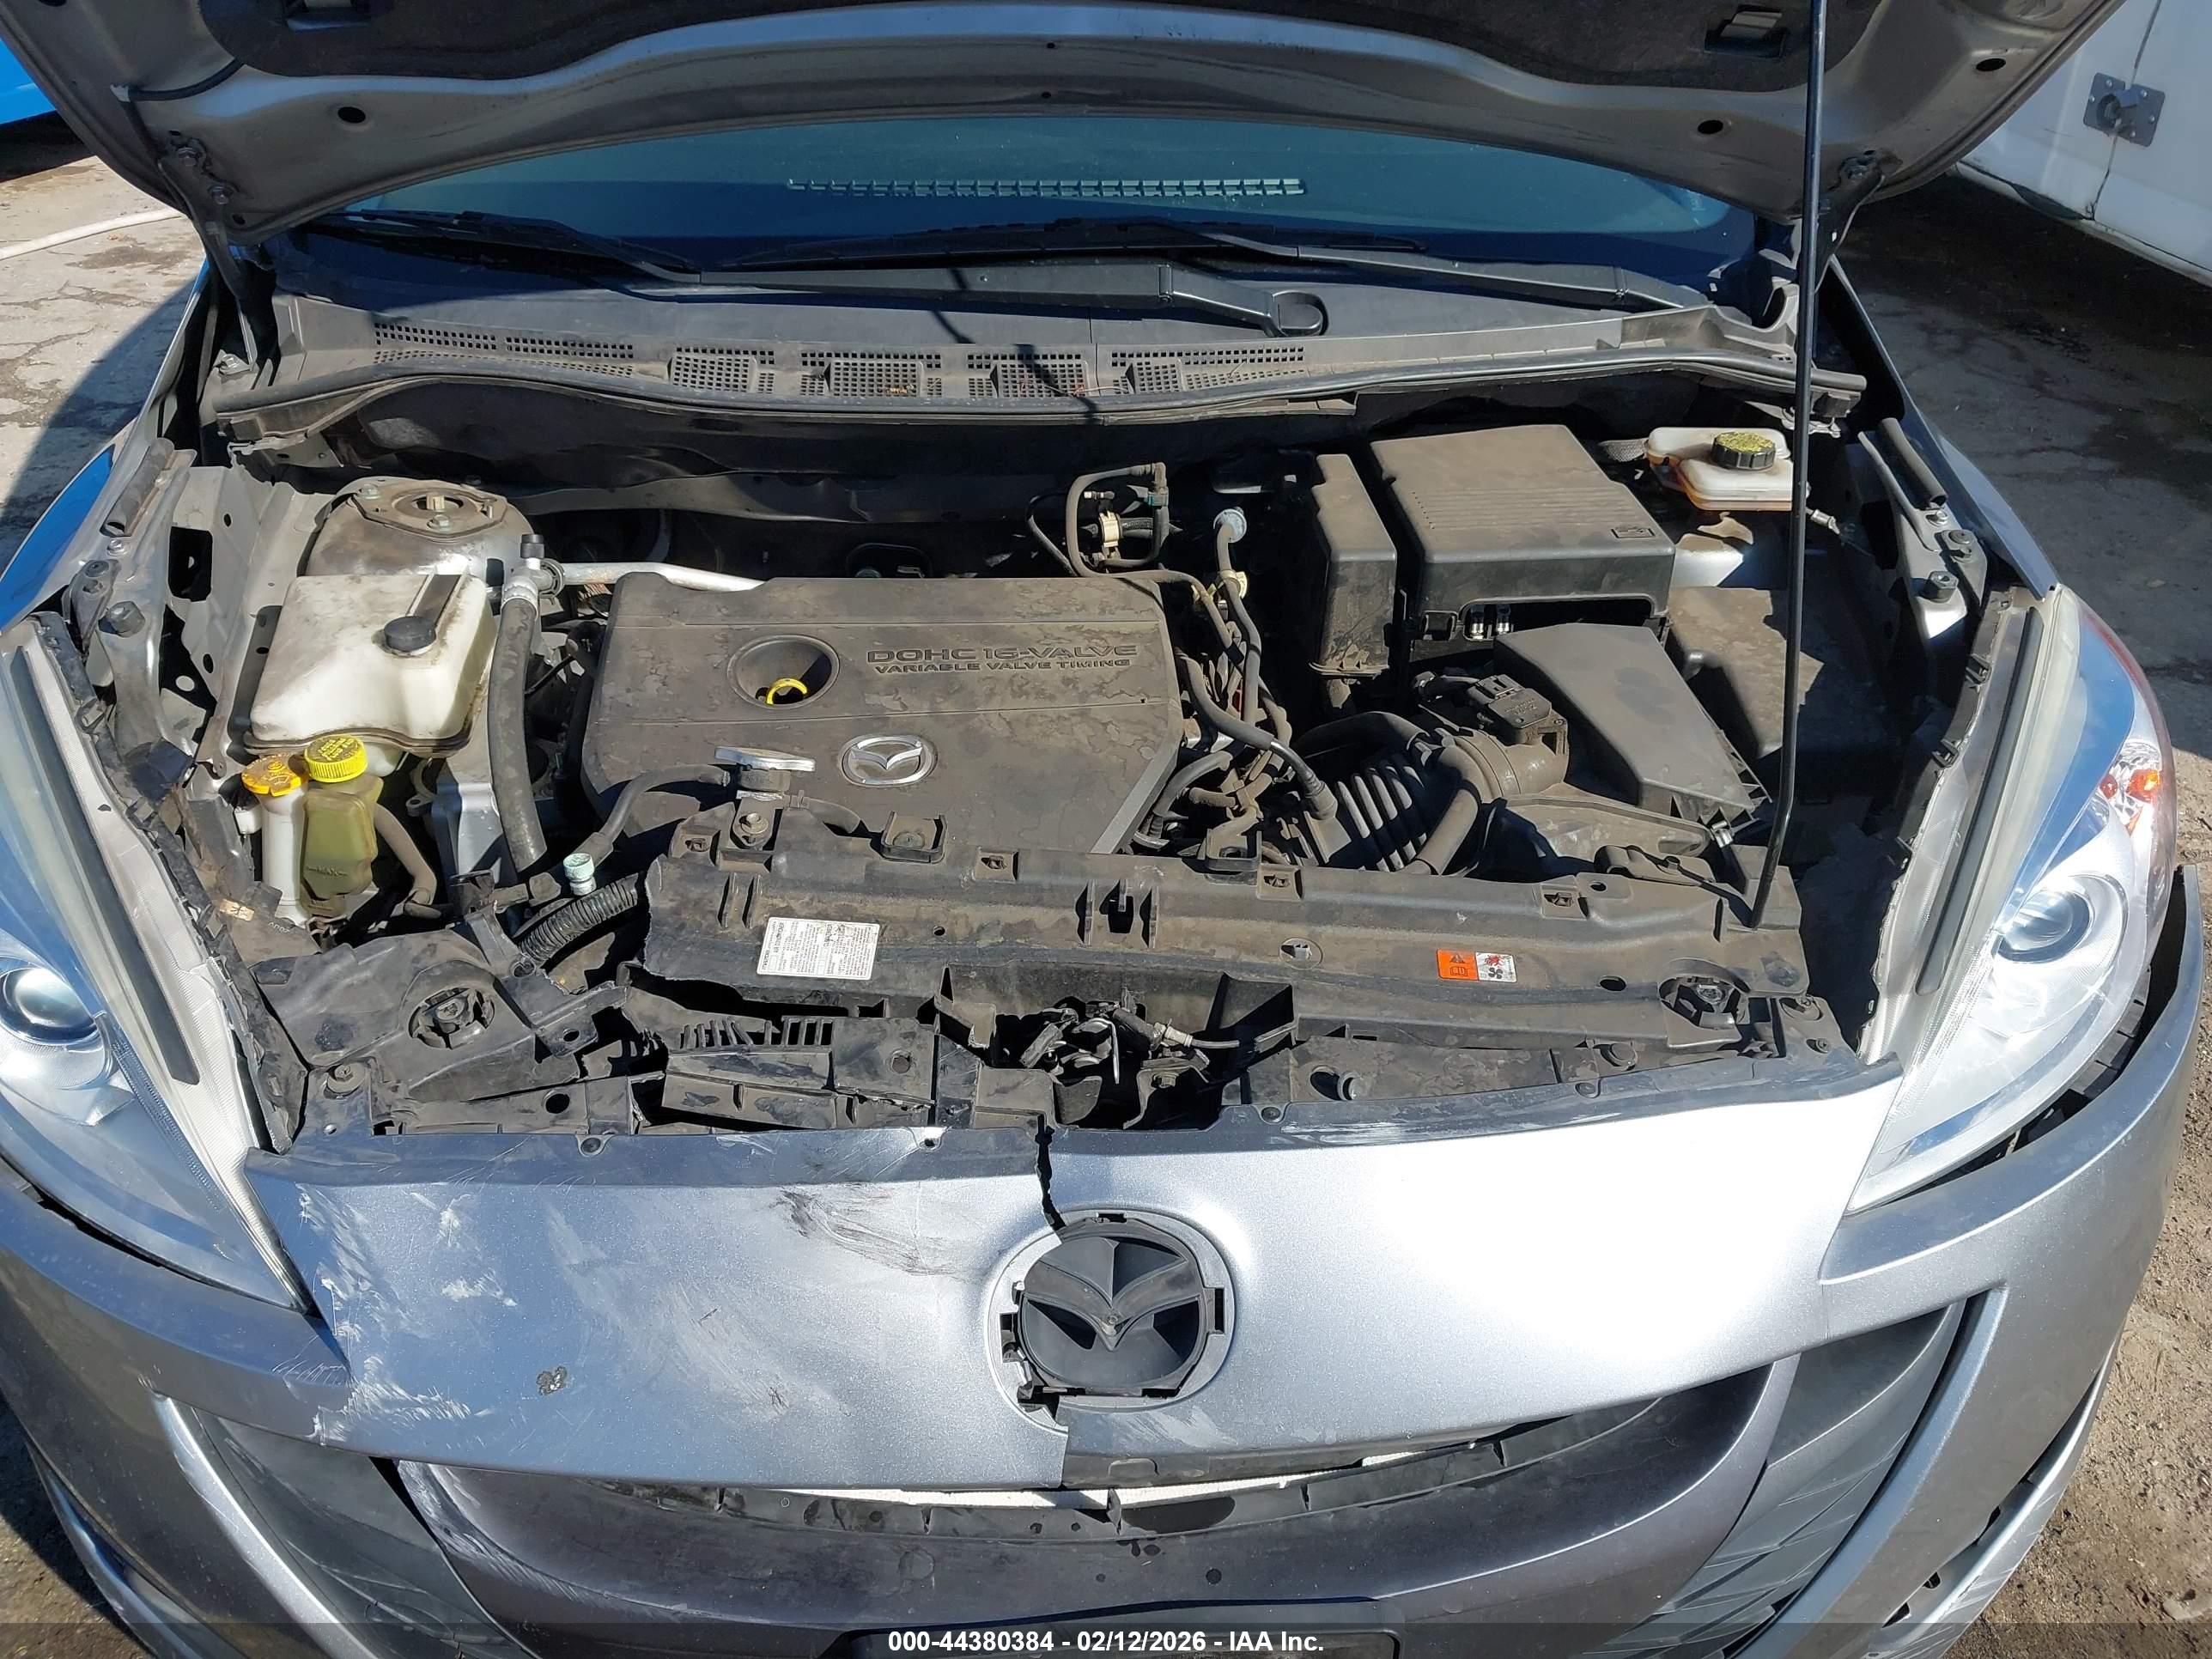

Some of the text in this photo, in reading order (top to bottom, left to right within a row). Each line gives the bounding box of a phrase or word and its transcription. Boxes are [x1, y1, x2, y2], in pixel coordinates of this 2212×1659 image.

[867, 645, 1138, 663] DOHC 16-VALVE
[875, 659, 1131, 674] VARIABLE VALVE TIMING
